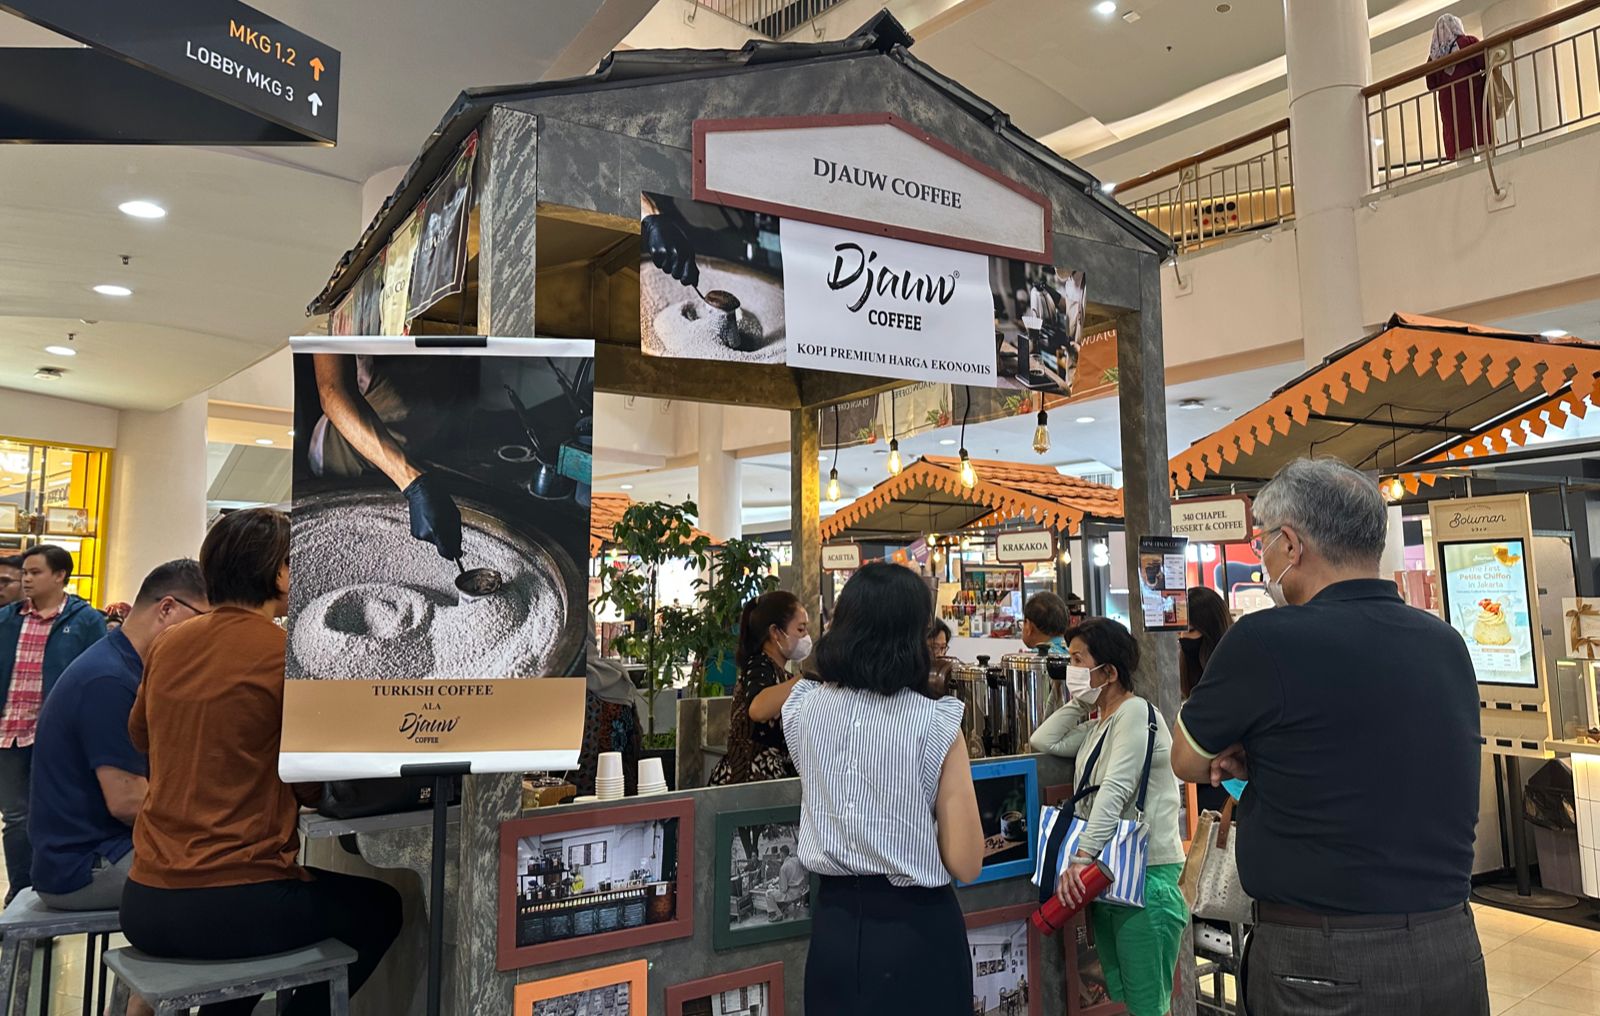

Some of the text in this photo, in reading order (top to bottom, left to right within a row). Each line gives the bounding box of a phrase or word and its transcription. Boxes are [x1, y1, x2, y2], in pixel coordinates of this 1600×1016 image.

[229, 19, 272, 54] MKG
[186, 40, 295, 101] LOBBY MKG 3
[813, 157, 962, 209] DJAUW COFFEE
[827, 242, 956, 313] Djauw
[868, 309, 921, 331] COFFEE
[797, 343, 991, 375] KOPI PREMIUM HARGA EKONOMIS
[1183, 511, 1227, 521] 340 CHAPEL
[1205, 523, 1211, 531] &
[1212, 520, 1244, 530] COFFEE
[1002, 542, 1048, 552] KRAKAKOA
[844, 553, 855, 561] TEA
[1483, 572, 1511, 580] Chiffon
[1477, 580, 1504, 588] Jakarta
[372, 685, 494, 696] TURKISH COFFEE
[421, 702, 441, 711] ALA
[399, 712, 458, 740] Djauw
[415, 736, 439, 744] COFFEE
